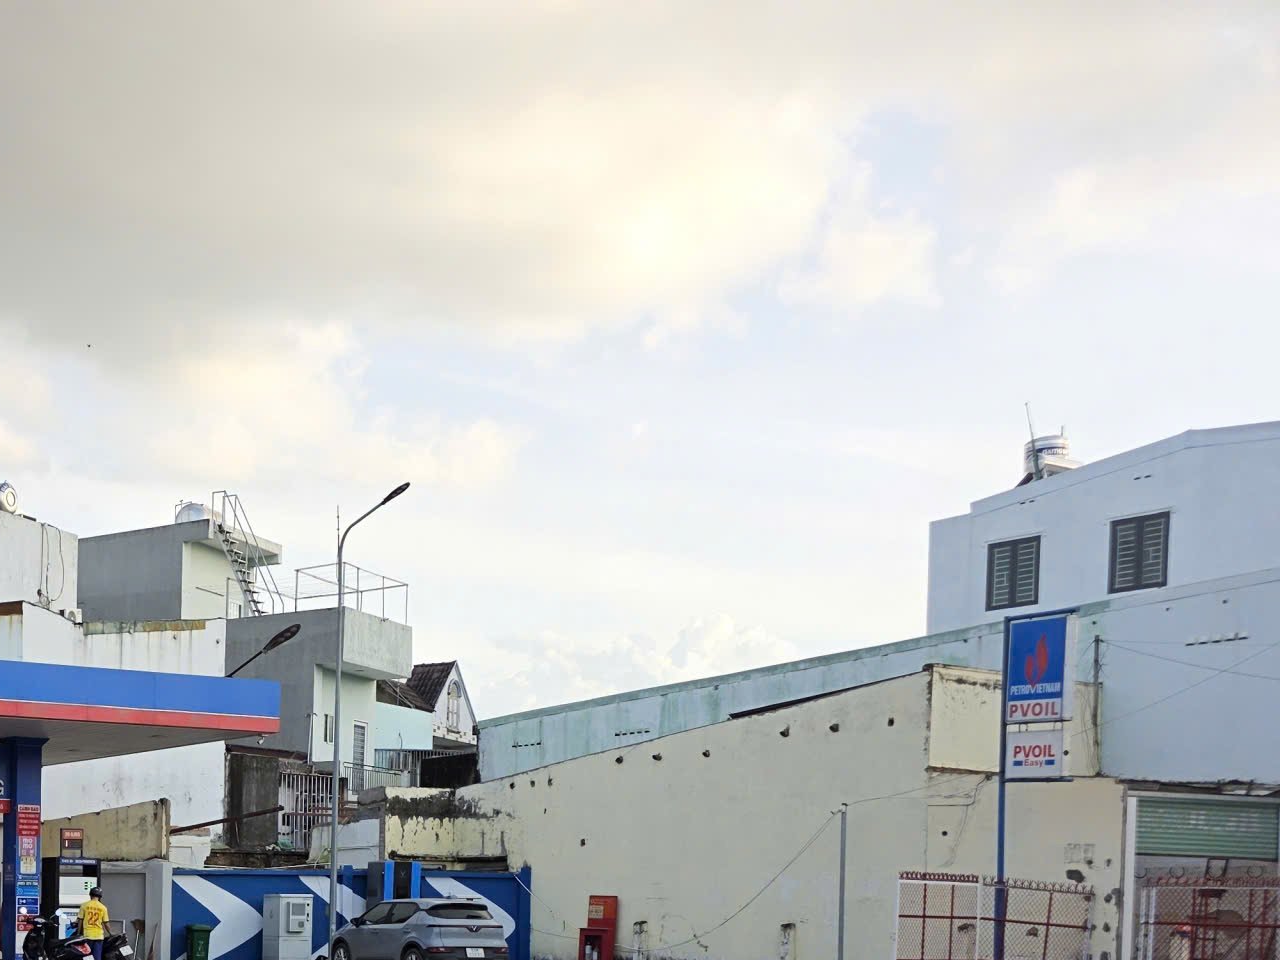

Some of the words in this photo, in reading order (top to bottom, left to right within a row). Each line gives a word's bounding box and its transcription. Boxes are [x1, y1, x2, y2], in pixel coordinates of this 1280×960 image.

[1010, 682, 1061, 696] PETROVIETNAM
[1009, 701, 1059, 718] PVOIL
[1013, 744, 1056, 759] PVOIL
[1024, 759, 1044, 768] Easy
[87, 911, 99, 925] 22
